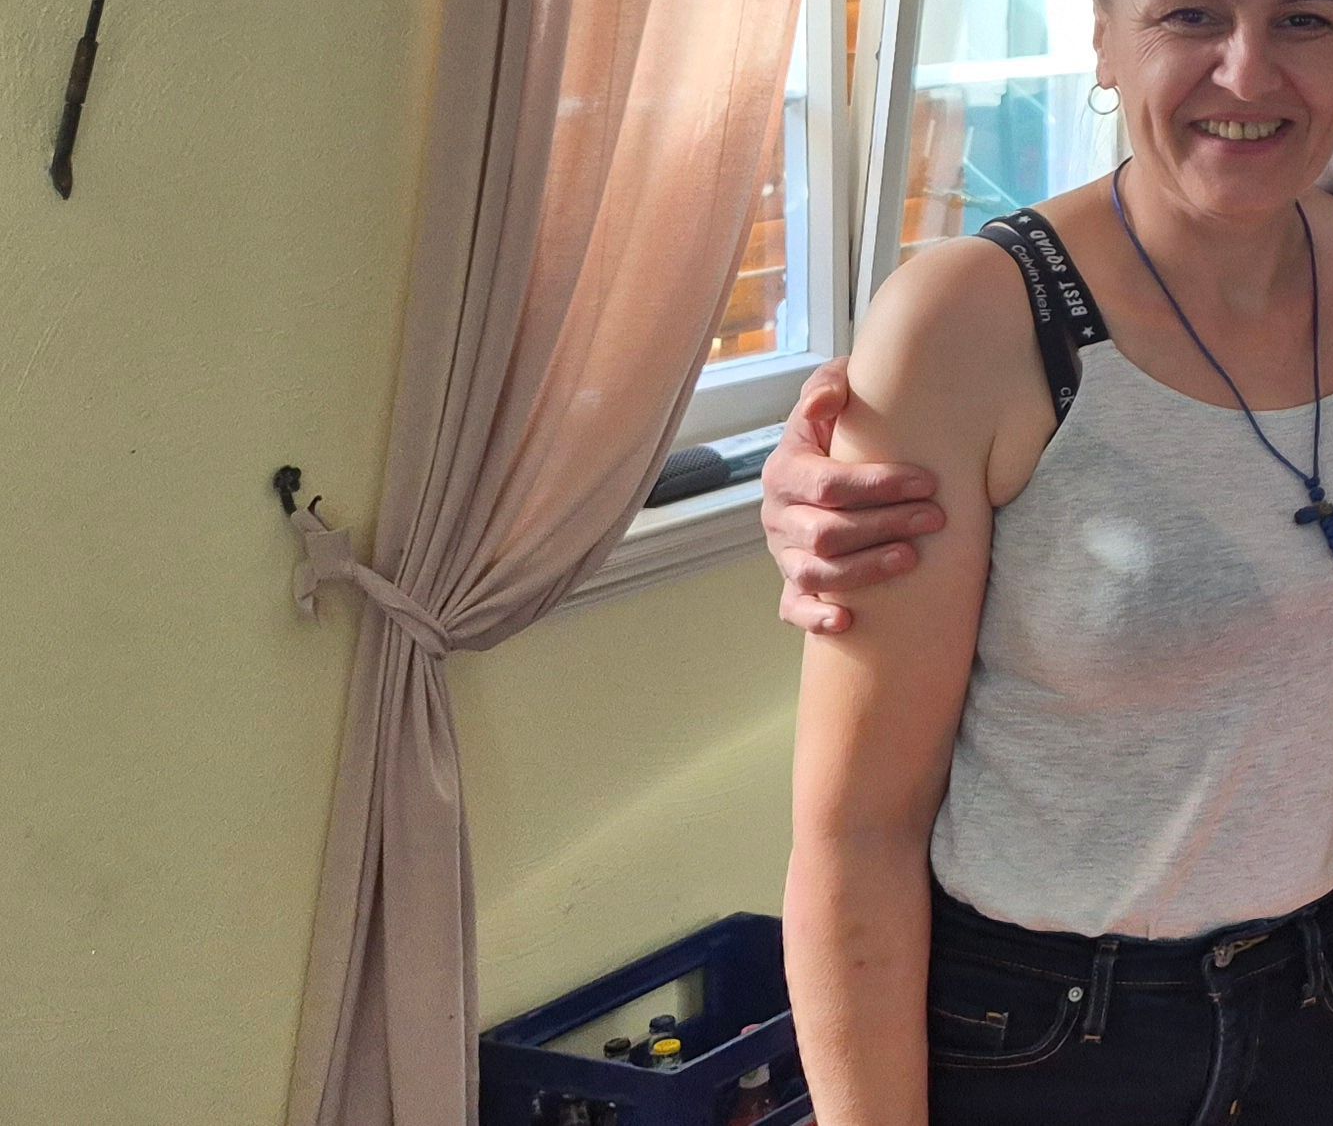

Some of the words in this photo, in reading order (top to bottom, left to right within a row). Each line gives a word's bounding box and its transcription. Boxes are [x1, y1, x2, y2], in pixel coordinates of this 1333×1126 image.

[1029, 229, 1068, 273] SQUAD
[1011, 244, 1041, 283] Calvin
[1034, 283, 1051, 322] Klein
[1058, 281, 1089, 317] BEST
